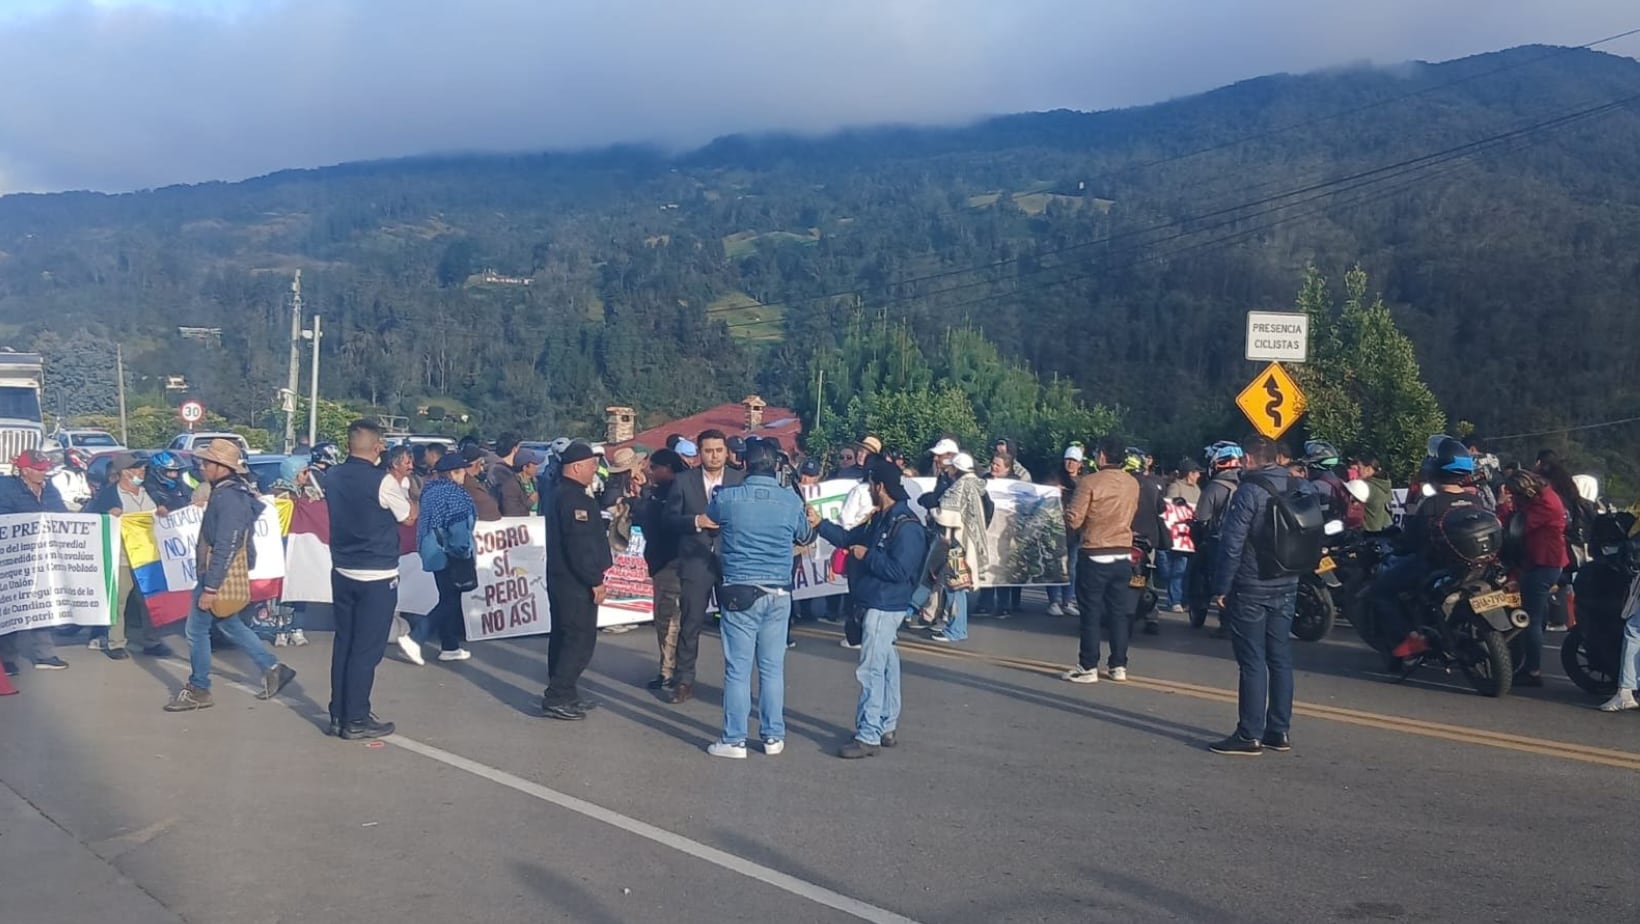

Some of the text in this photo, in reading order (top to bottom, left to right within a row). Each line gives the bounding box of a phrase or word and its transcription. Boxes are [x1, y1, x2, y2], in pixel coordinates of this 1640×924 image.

[1252, 323, 1302, 334] PRESENCIA
[1254, 339, 1300, 350] CICLISTAS
[184, 406, 200, 417] 30
[475, 524, 530, 556] COBRO
[6, 543, 19, 553] del
[164, 536, 187, 561] NO
[24, 567, 30, 577] y
[67, 563, 98, 573] Poblado
[9, 577, 34, 589] Unión
[485, 576, 529, 608] PERO
[481, 594, 538, 635] NO ASÍ
